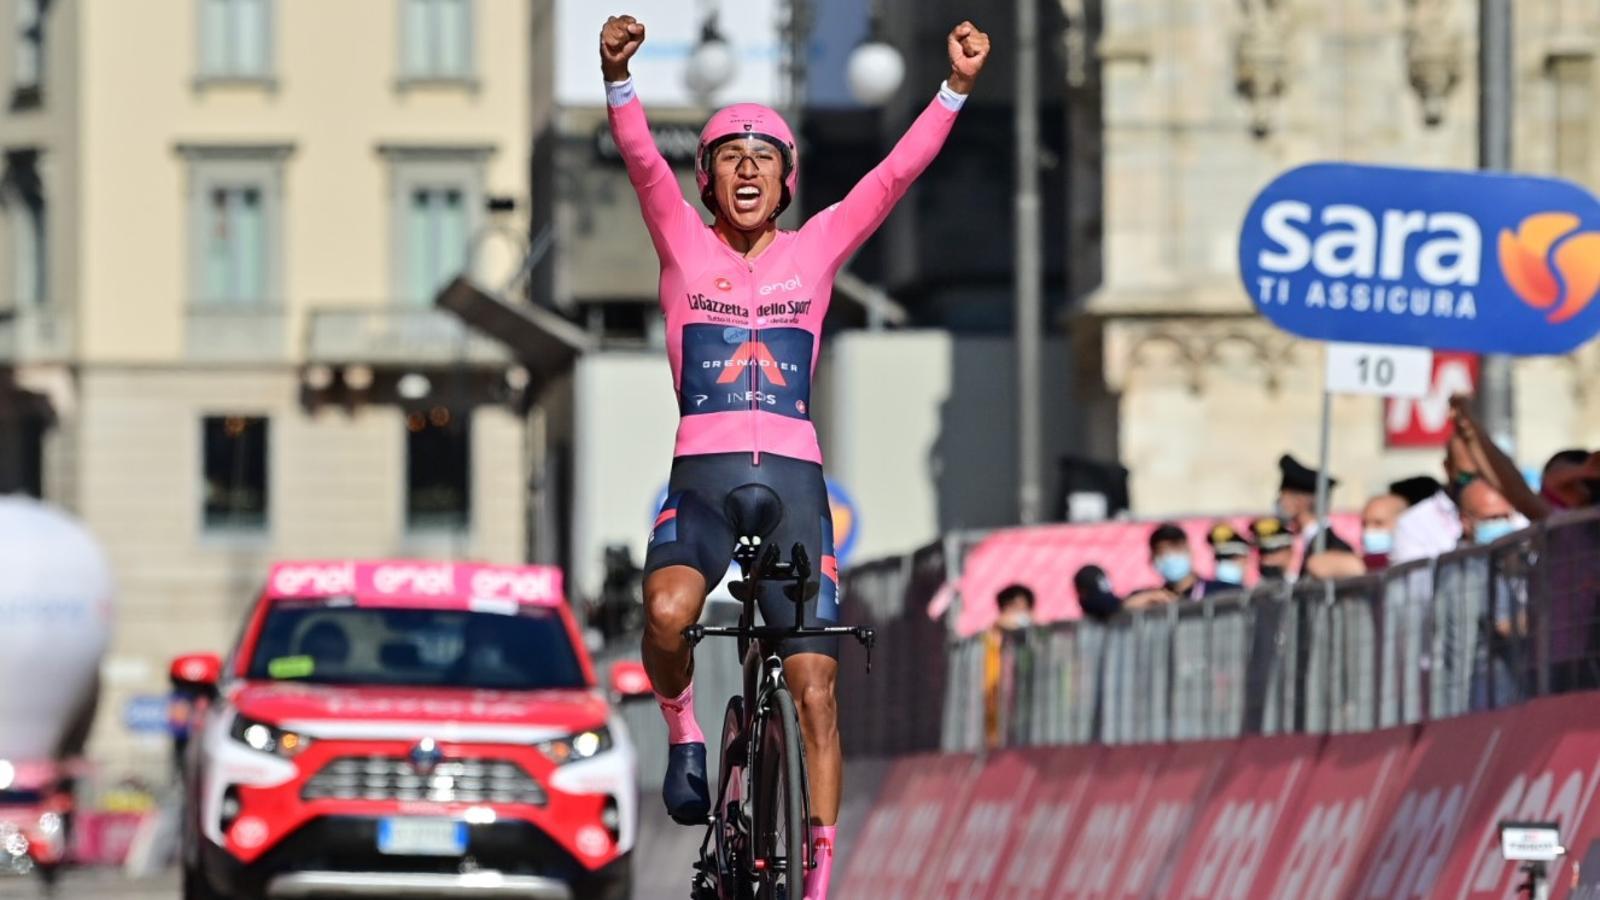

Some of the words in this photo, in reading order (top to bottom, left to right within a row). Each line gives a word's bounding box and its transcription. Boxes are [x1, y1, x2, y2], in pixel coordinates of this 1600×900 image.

[1257, 200, 1483, 287] sara
[759, 274, 802, 296] enel
[1257, 276, 1290, 306] TI
[1305, 280, 1478, 320] ASSICURA
[756, 303, 786, 317] dello
[787, 299, 812, 317] Sport
[702, 359, 798, 372] GRENADIER
[1354, 356, 1396, 388] 10
[727, 391, 777, 405] INEOS
[274, 564, 356, 595] enel
[373, 563, 455, 595] enel
[471, 568, 553, 602] enel
